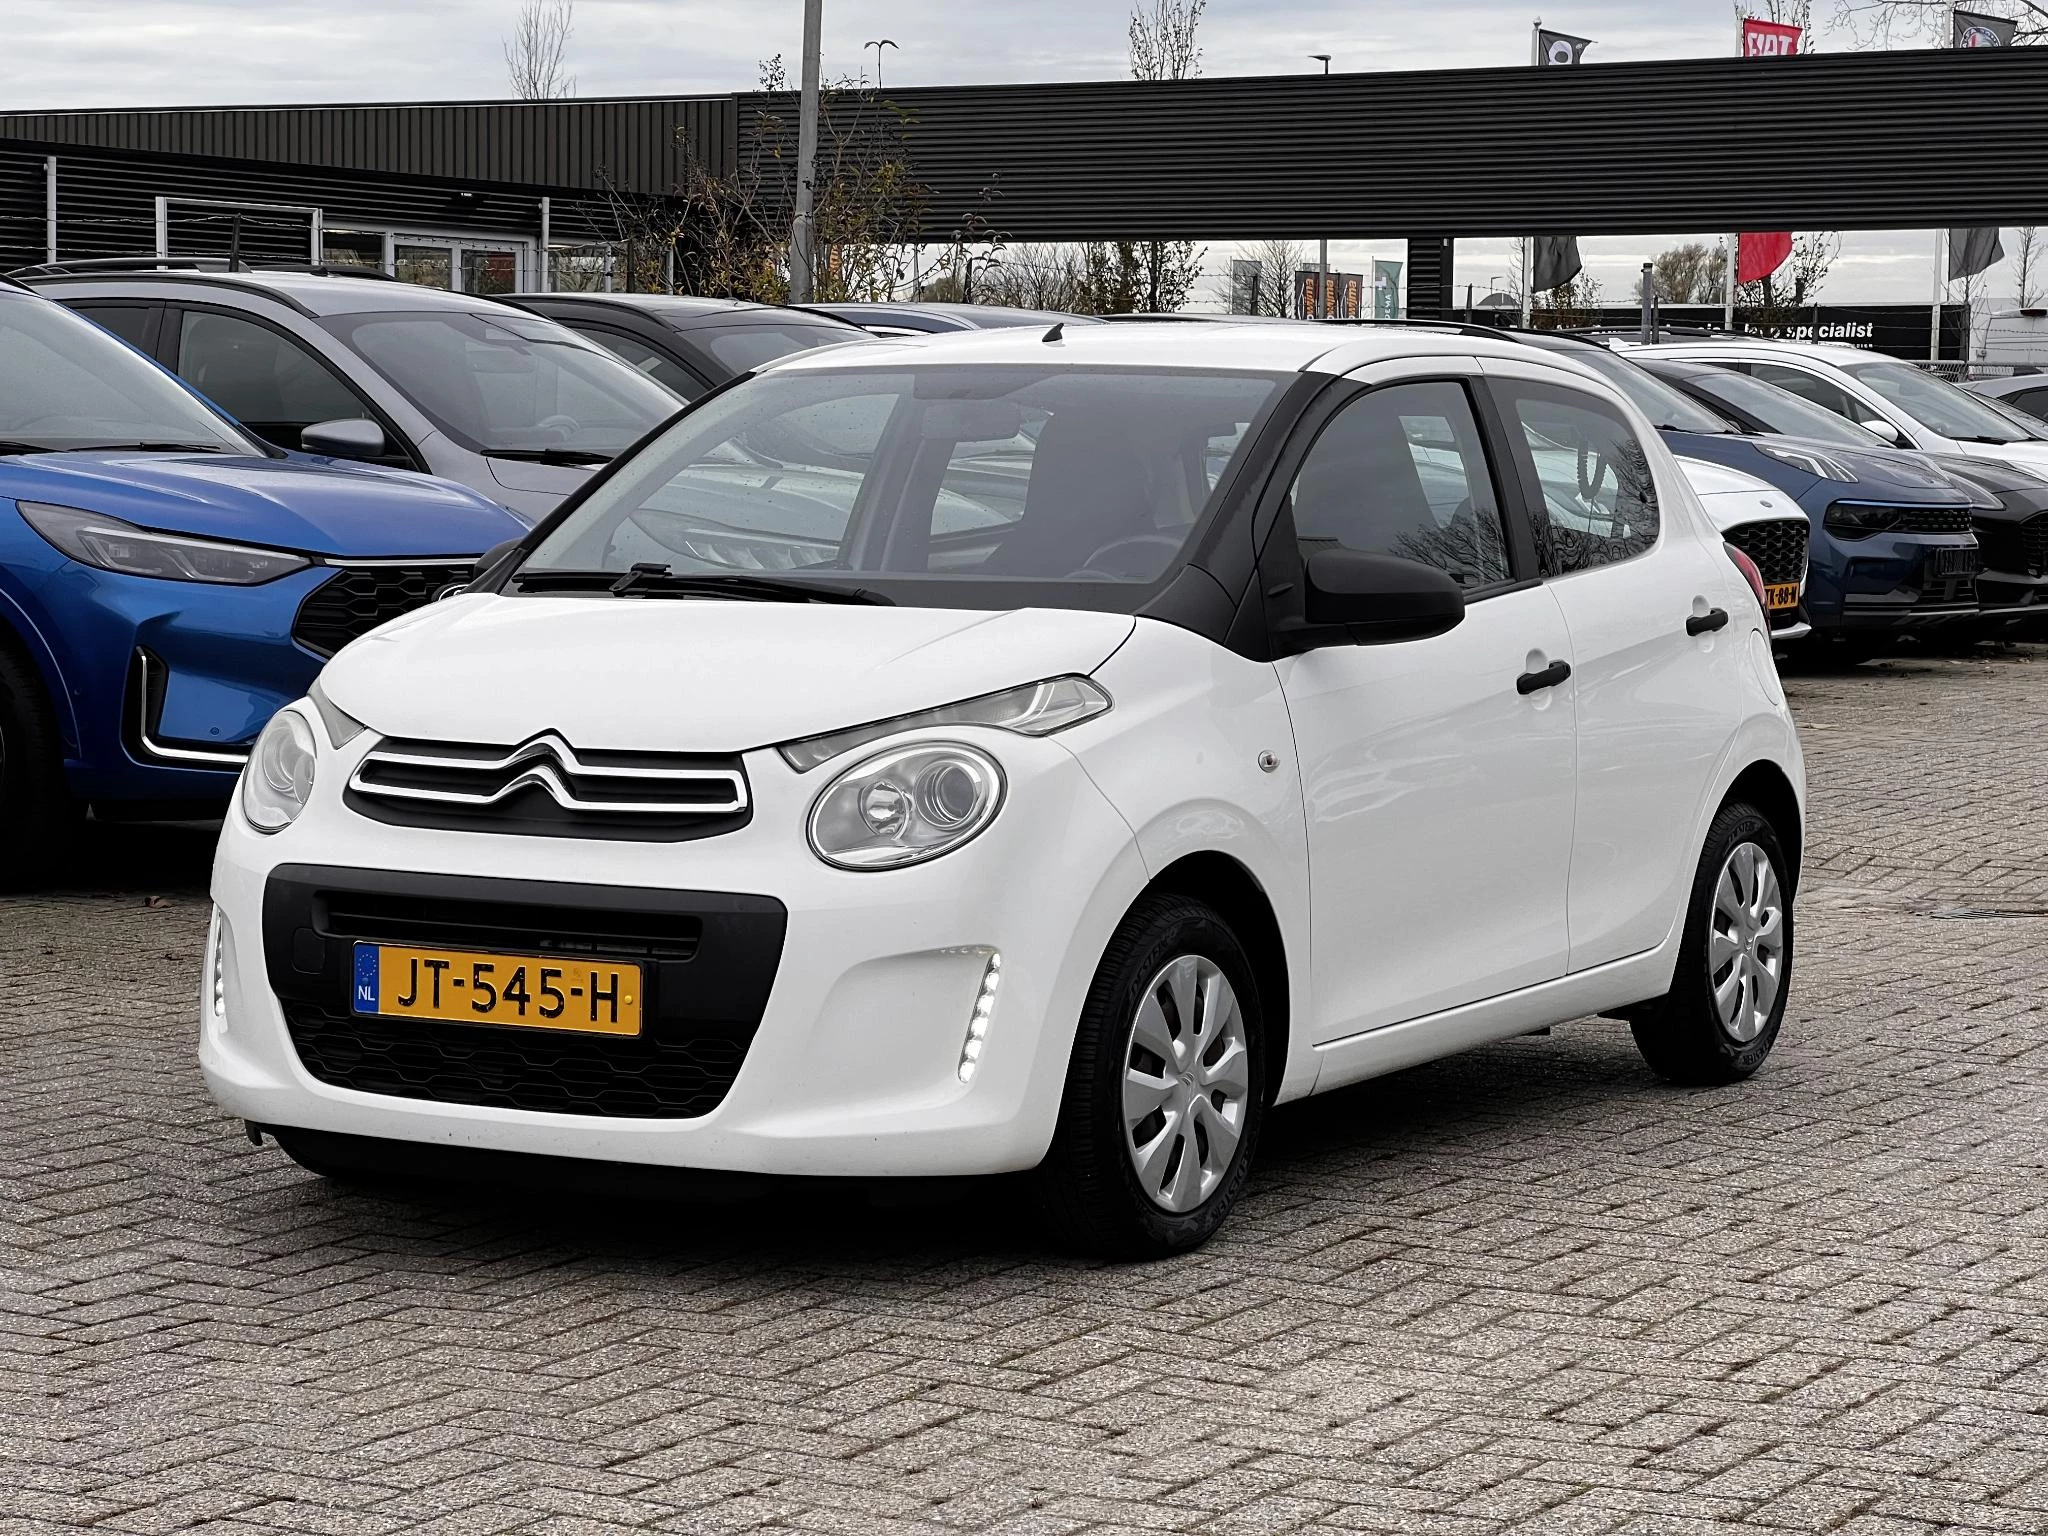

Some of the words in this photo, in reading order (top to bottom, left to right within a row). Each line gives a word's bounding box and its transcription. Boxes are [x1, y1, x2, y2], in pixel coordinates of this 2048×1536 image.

[1747, 32, 1793, 57] FIAT
[357, 985, 375, 1002] NL
[397, 957, 619, 1024] JT-545-H
